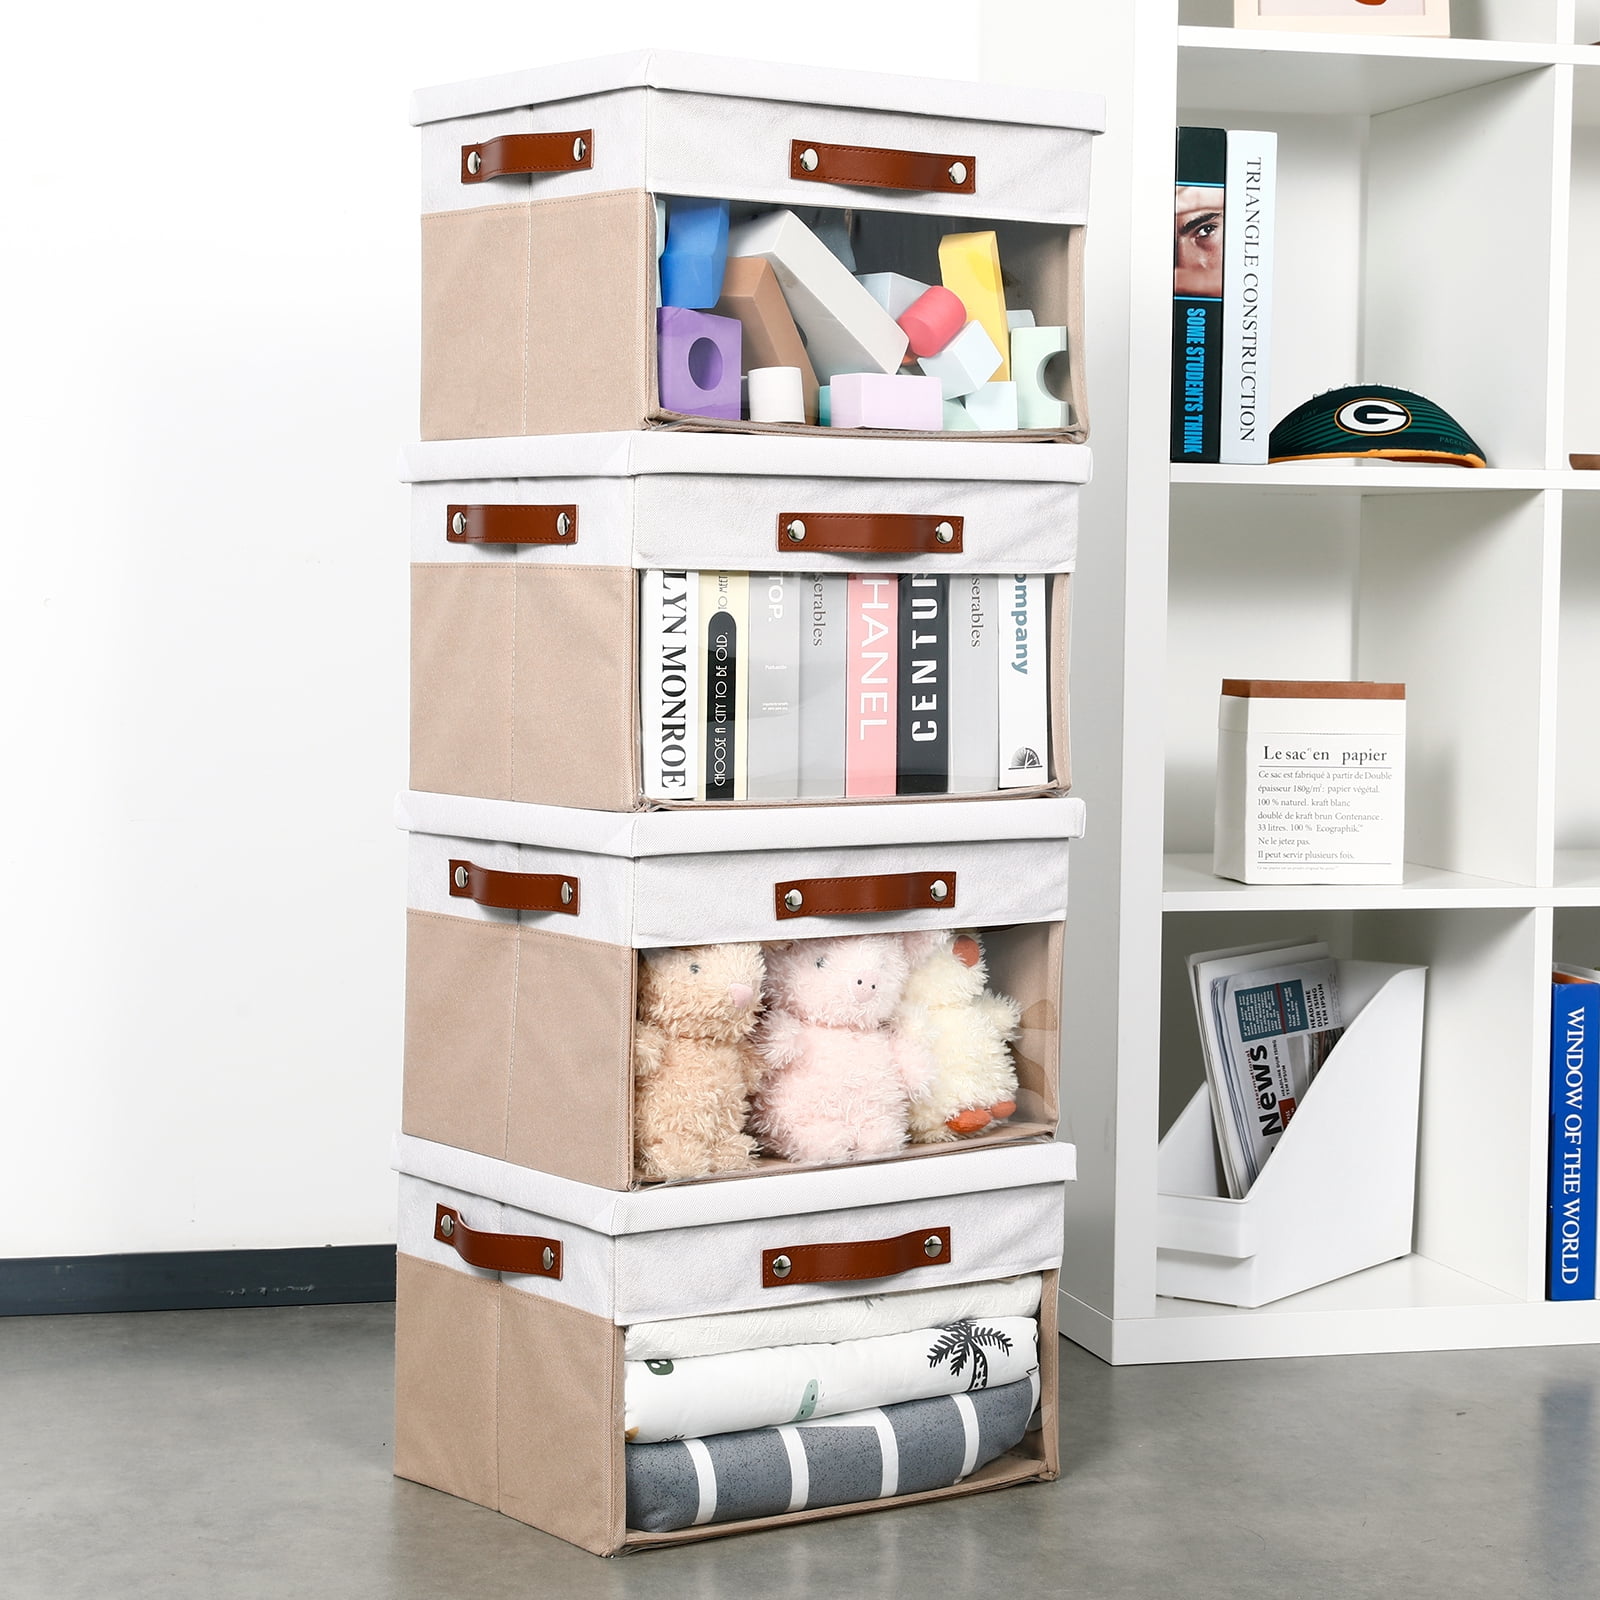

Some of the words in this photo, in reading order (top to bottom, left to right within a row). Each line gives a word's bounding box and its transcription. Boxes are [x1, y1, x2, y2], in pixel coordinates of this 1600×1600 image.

[1244, 156, 1262, 267] TRIANGLE
[1186, 307, 1206, 345] SOME
[1239, 273, 1260, 443] CONSTRUCTION
[1184, 346, 1205, 412] STUDENTS
[1183, 414, 1203, 454] THINK
[662, 570, 687, 635] LYN
[715, 665, 728, 677] BE
[715, 681, 728, 699] TO
[661, 644, 687, 789] MONROE
[715, 703, 727, 724] CITY
[714, 737, 727, 787] CHOOSE
[1264, 745, 1282, 760] Le
[1313, 751, 1329, 761] en
[1342, 748, 1388, 766] papier
[1257, 784, 1291, 794] épaisseur
[1327, 785, 1351, 795] papier
[1258, 770, 1269, 779] Ce
[1294, 770, 1325, 781] fabriqué
[1332, 771, 1353, 781] partir
[1353, 771, 1364, 779] de
[1364, 771, 1393, 780] Double
[1258, 798, 1271, 806] 100
[1311, 798, 1329, 806] kraft
[1330, 798, 1351, 807] blanc
[1284, 811, 1295, 820] de
[1295, 811, 1313, 820] kraft
[1314, 811, 1333, 820] brun
[1257, 823, 1267, 831] 33
[1290, 823, 1303, 831] 100
[1258, 837, 1269, 845] Ne
[1270, 836, 1278, 845] le
[1278, 836, 1295, 847] jetez
[1264, 851, 1281, 861] peut
[1282, 851, 1303, 859] servir
[1304, 850, 1338, 861] plusieurs
[1305, 990, 1316, 1029] HEADLINE
[1564, 1007, 1585, 1110] WINDOW
[1249, 1045, 1283, 1137] News
[1564, 1115, 1582, 1145] OF
[1562, 1148, 1581, 1195] THE
[1561, 1200, 1580, 1286] WORLD
